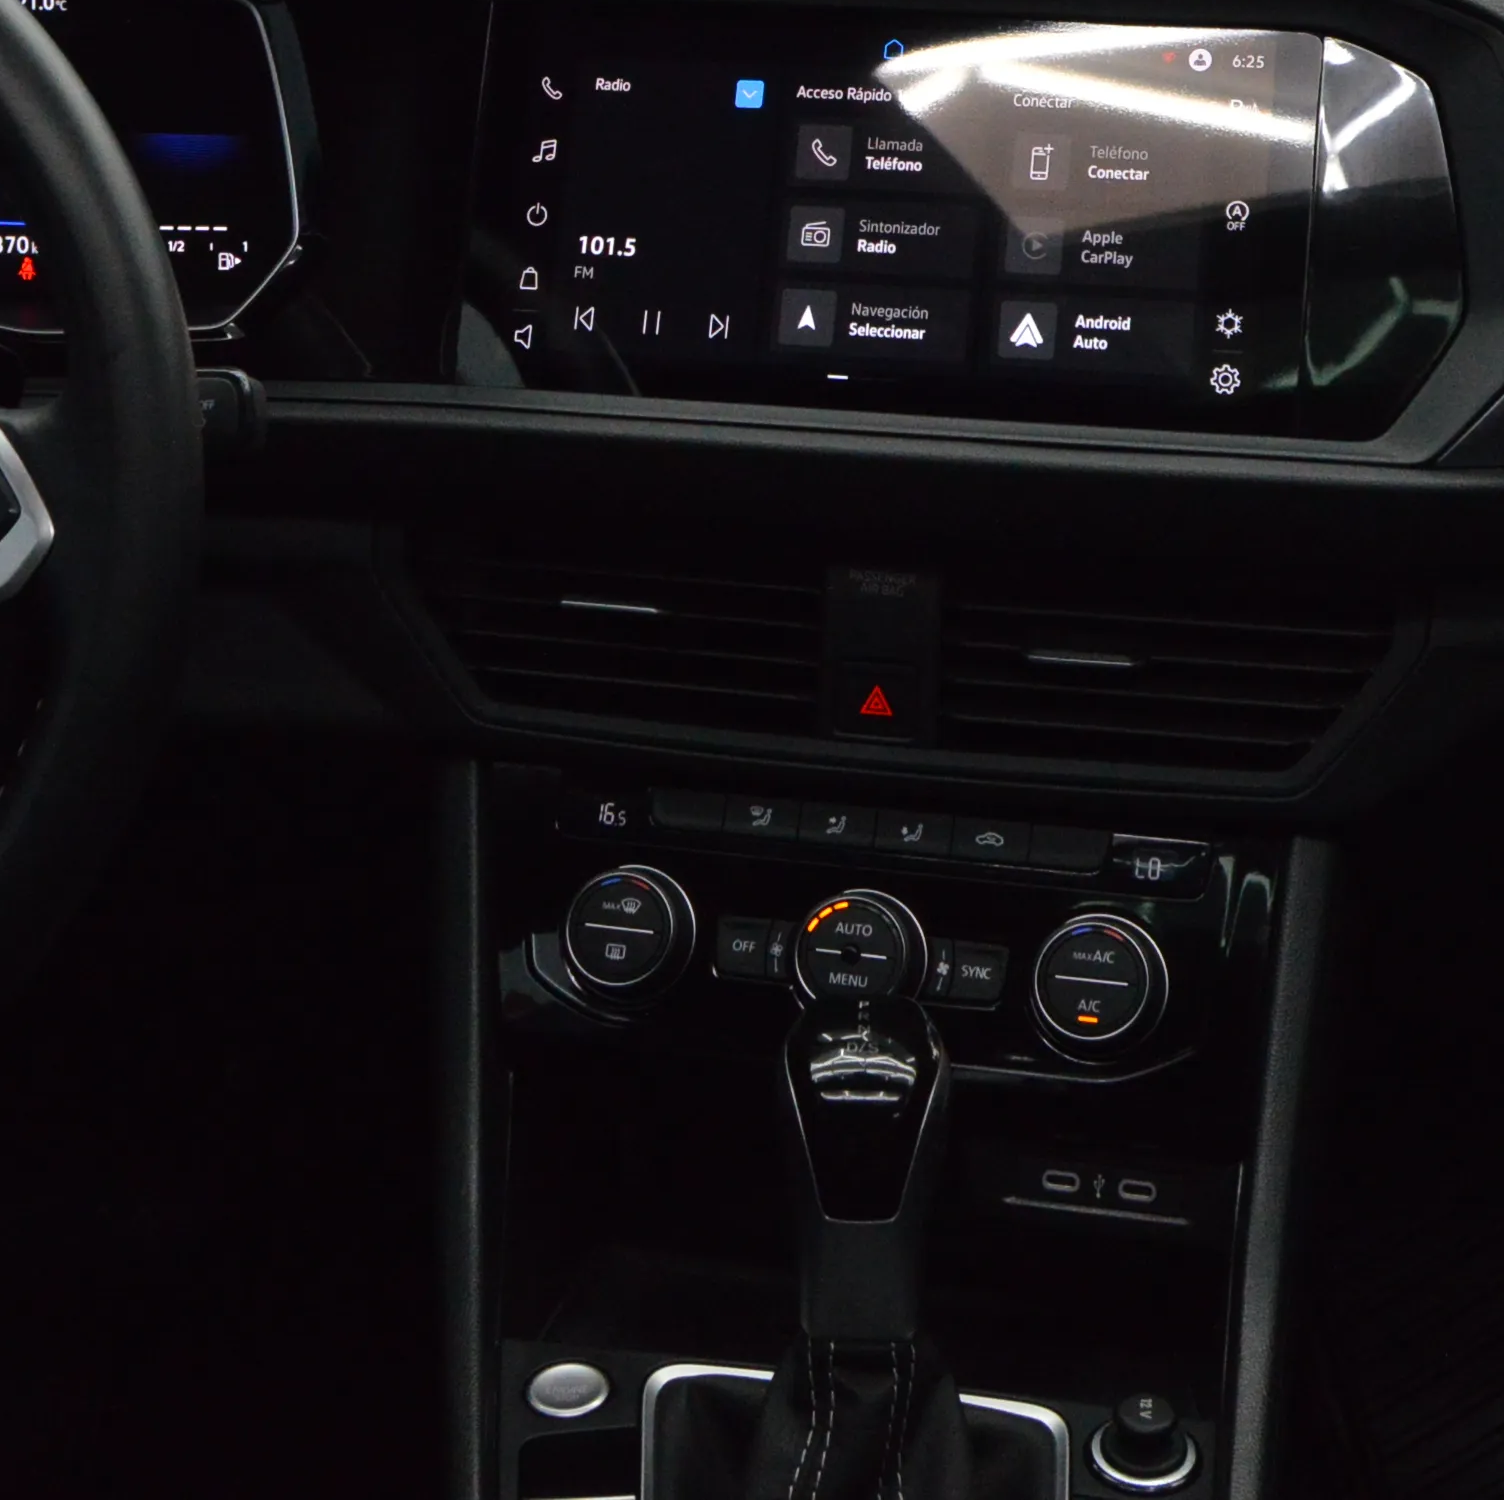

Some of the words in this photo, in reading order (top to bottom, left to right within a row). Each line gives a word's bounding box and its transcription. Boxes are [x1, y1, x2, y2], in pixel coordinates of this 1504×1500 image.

[1232, 55, 1265, 68] 6:25
[595, 77, 631, 92] Radio
[796, 85, 844, 100] Acceso
[846, 86, 892, 103] Rápido
[1013, 93, 1074, 110] Conectar
[867, 137, 923, 152] Llamada
[1090, 145, 1149, 161] Teléfono
[865, 156, 923, 172] Teléfono
[1087, 165, 1150, 181] Conectar
[859, 219, 941, 237] Sintonizador
[1227, 221, 1245, 231] OFF
[578, 235, 637, 257] 101.5
[857, 239, 897, 254] Radio
[1082, 230, 1123, 247] Apple
[1081, 250, 1134, 268] CarPlay
[573, 265, 595, 280] FM
[851, 303, 929, 321] Navegación
[1074, 315, 1132, 331] Android
[849, 323, 926, 341] Seleccionar
[1073, 335, 1108, 350] Auto
[834, 922, 873, 938] AUTO
[732, 938, 756, 954] OFF
[828, 972, 868, 988] MENU
[961, 965, 992, 981] SYNC
[1076, 998, 1101, 1014] A/C
